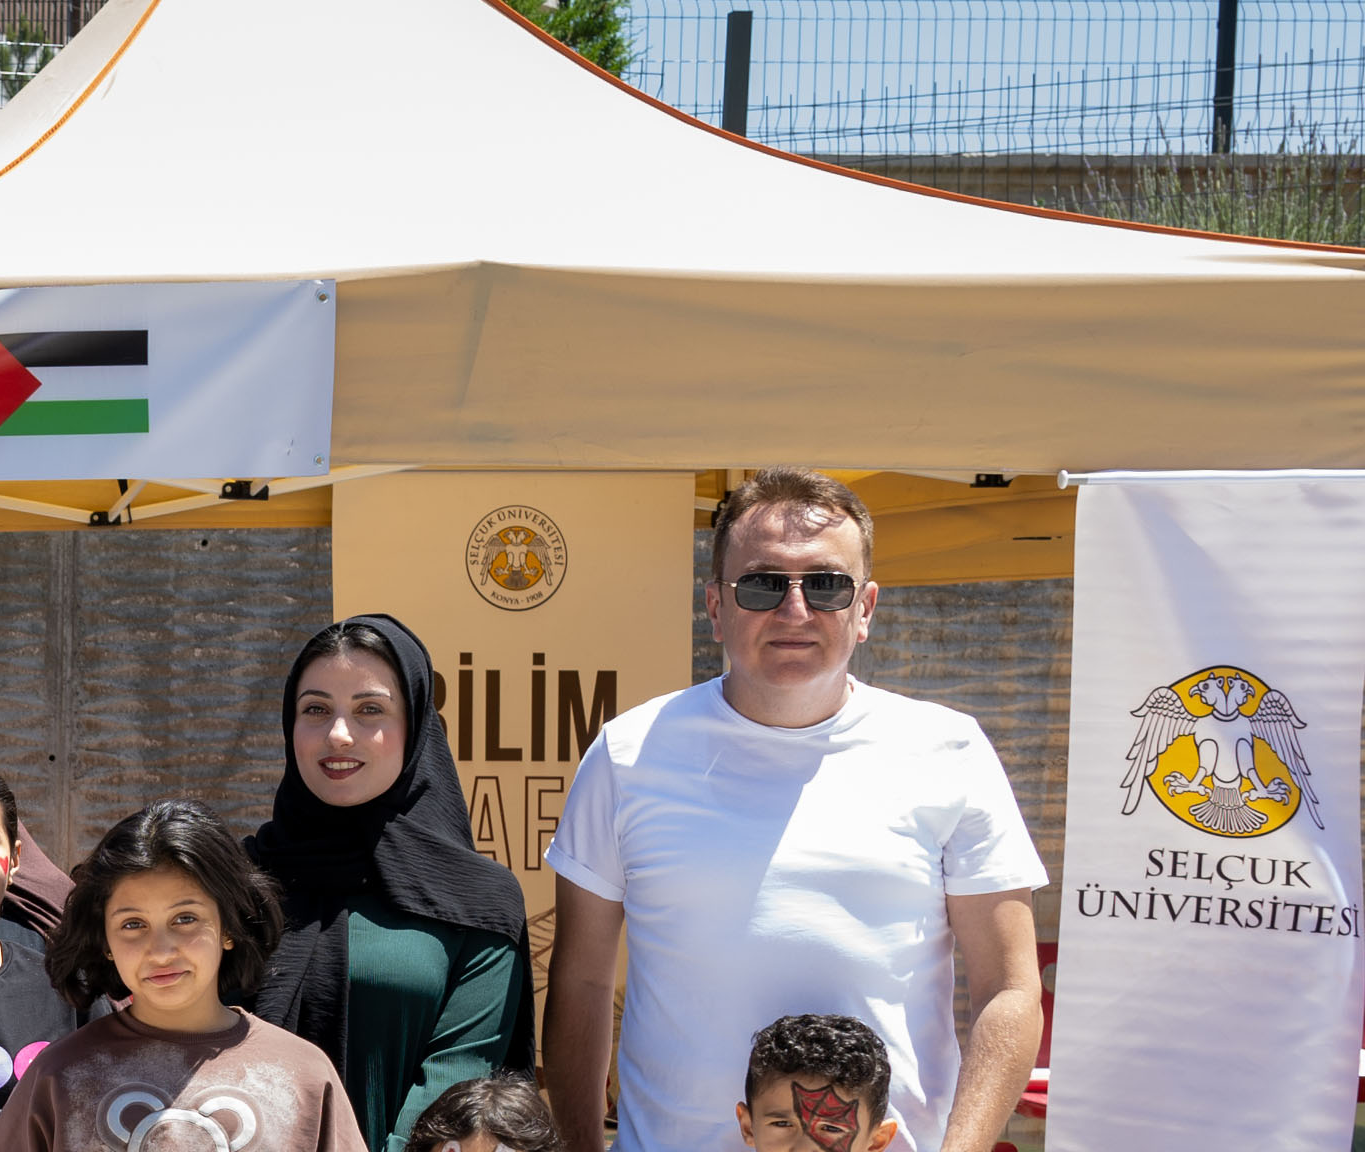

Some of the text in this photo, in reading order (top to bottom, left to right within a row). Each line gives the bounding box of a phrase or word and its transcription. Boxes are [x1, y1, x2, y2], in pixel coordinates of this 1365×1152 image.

[469, 508, 564, 566] SELÇUK ÜNİVERSİTESİ
[490, 590, 519, 605] KONYA
[526, 591, 543, 603] 1908
[1145, 848, 1311, 890] SELÇUK
[1076, 883, 1361, 938] ÜNİVERSİTESİ
